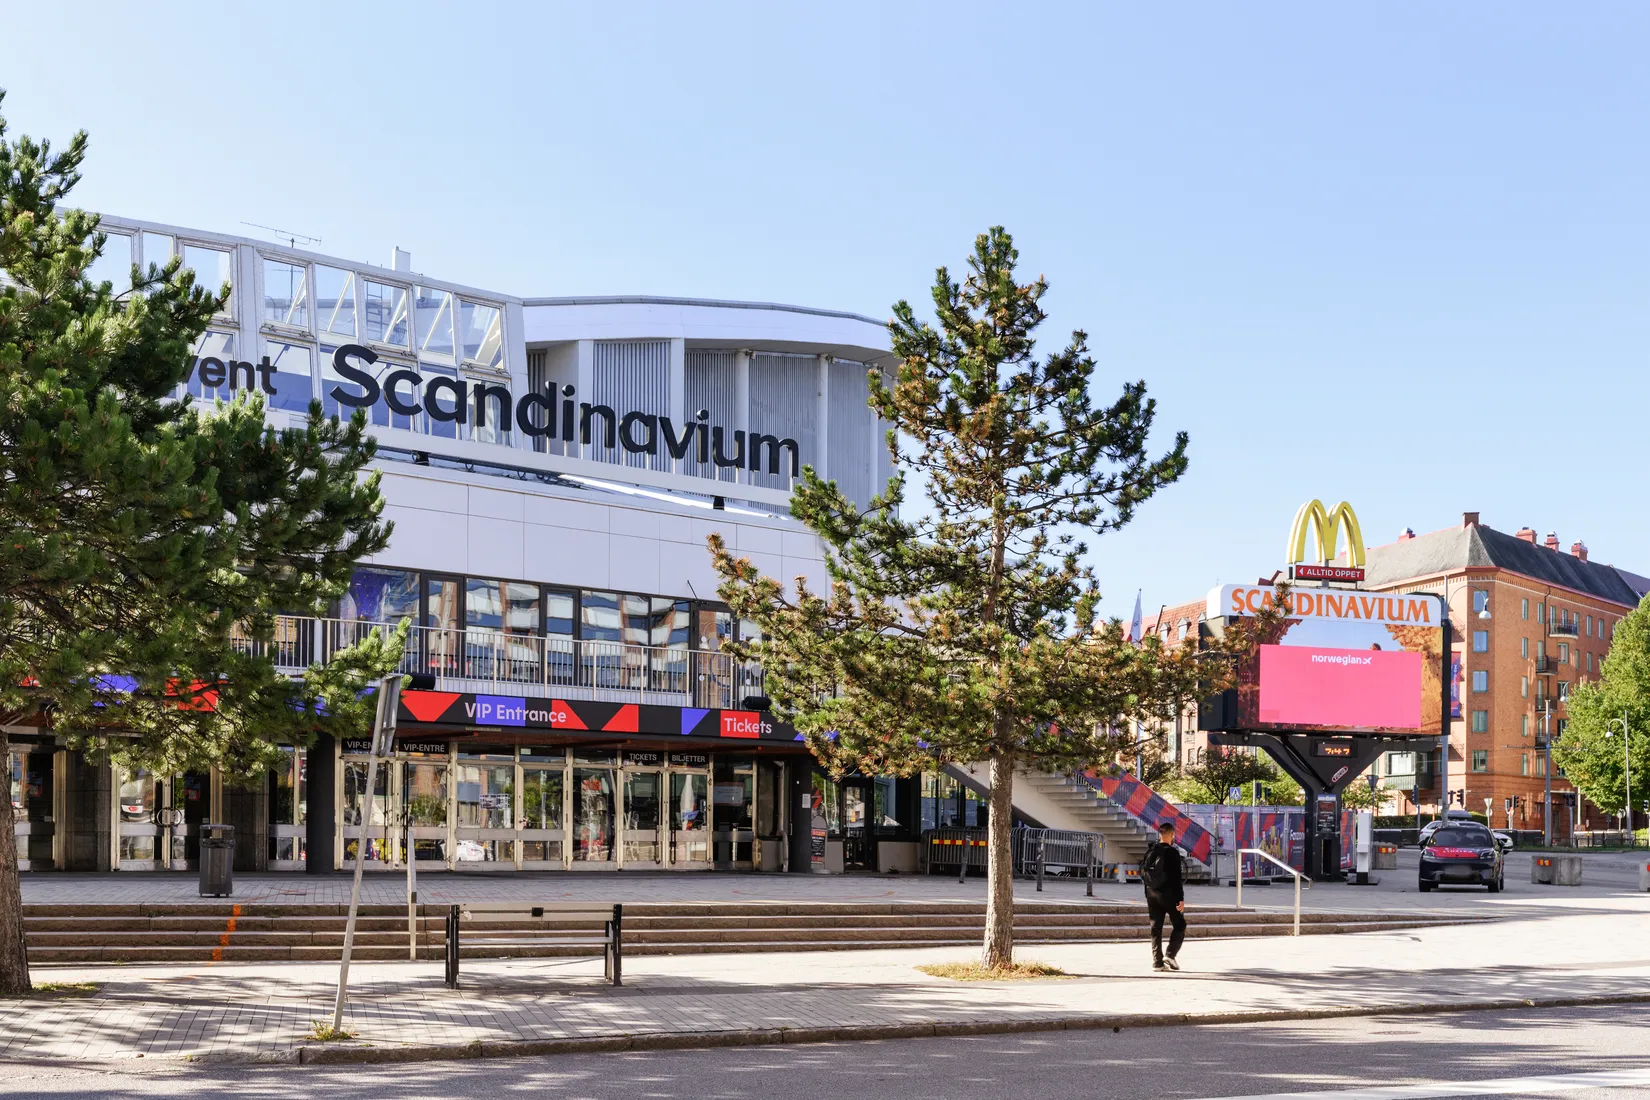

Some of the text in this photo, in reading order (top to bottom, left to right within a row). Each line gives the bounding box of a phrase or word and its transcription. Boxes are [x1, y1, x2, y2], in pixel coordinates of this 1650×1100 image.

[330, 343, 799, 478] Scandinavium
[1307, 569, 1361, 578] ALLTID ÖPPET
[1231, 587, 1430, 623] SCANDINAVIUM
[1311, 654, 1362, 666] norwegian
[465, 702, 567, 723] VIP Entrance
[724, 717, 773, 734] Tickets
[346, 740, 372, 749] VIP-EN
[629, 752, 657, 761] TICKETS
[671, 754, 706, 763] BILJETTER
